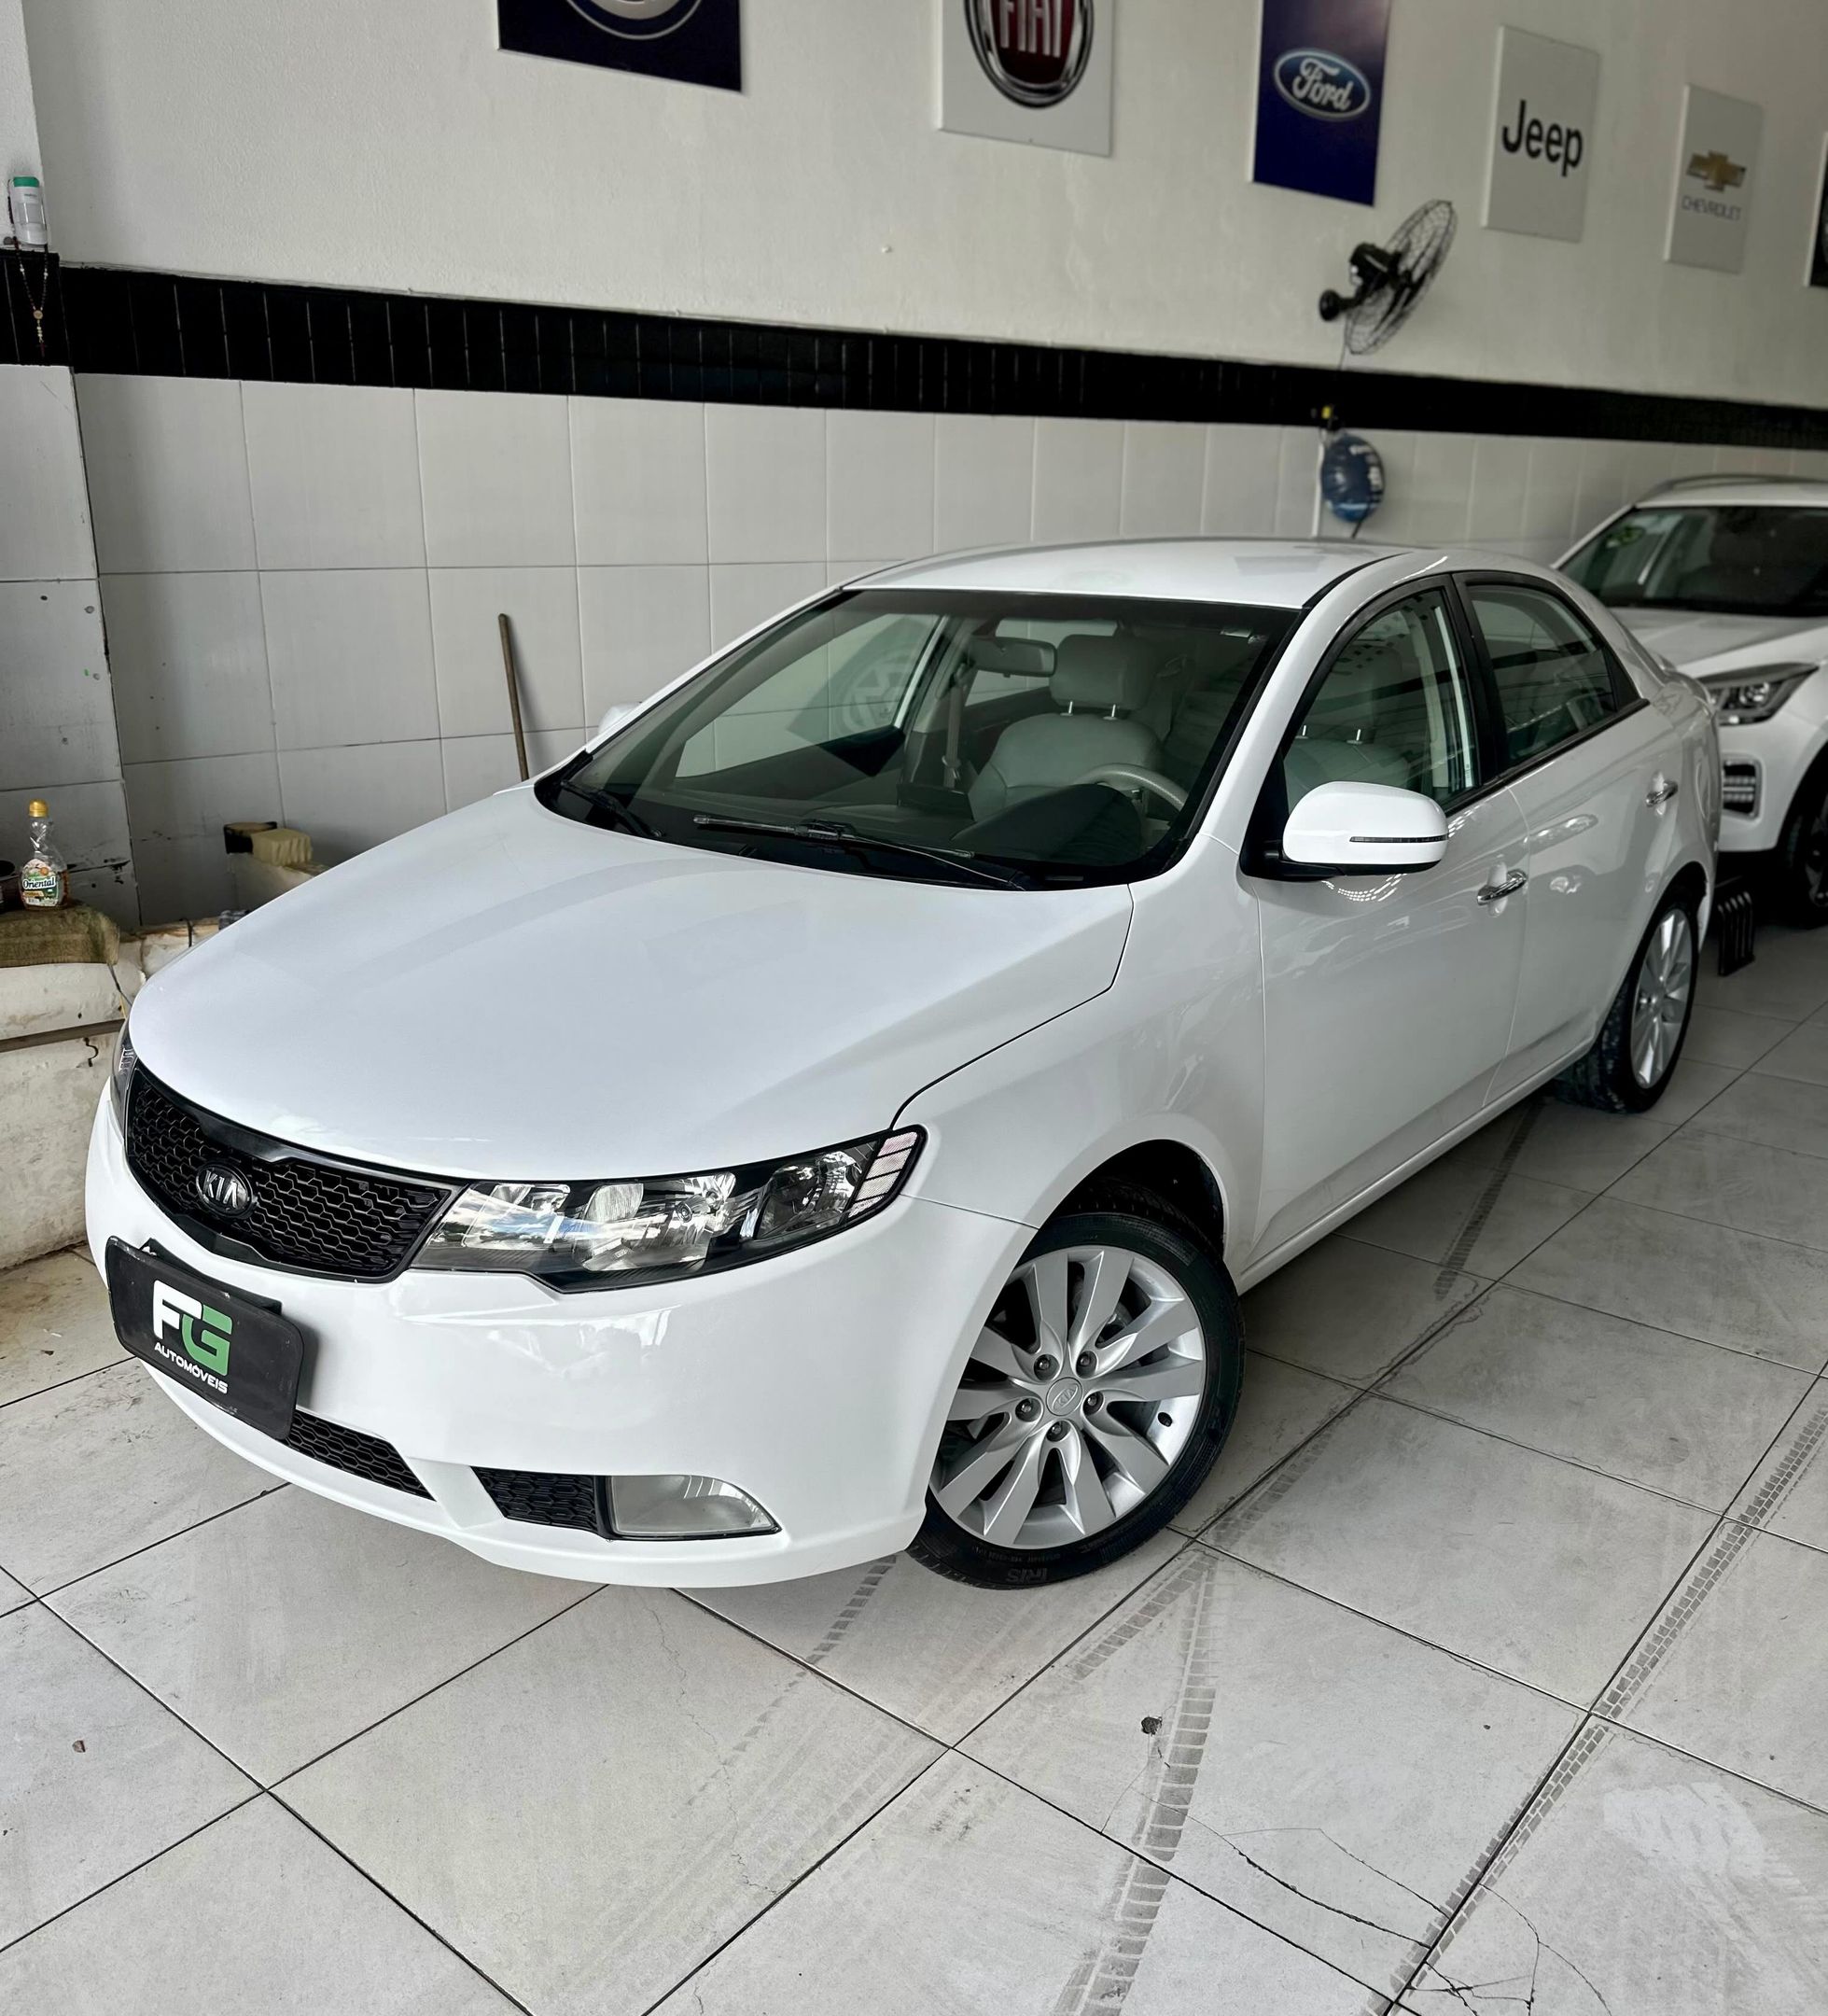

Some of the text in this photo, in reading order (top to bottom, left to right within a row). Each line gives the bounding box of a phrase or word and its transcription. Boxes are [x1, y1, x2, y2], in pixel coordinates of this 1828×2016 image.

[1292, 56, 1352, 112] Ford
[1502, 99, 1584, 177] Jeep
[1681, 195, 1742, 222] CHEVROLET
[22, 876, 56, 890] Oriental
[203, 1169, 240, 1210] KIA
[153, 1280, 232, 1376] FG
[154, 1341, 229, 1393] AUTOMÓVEIS
